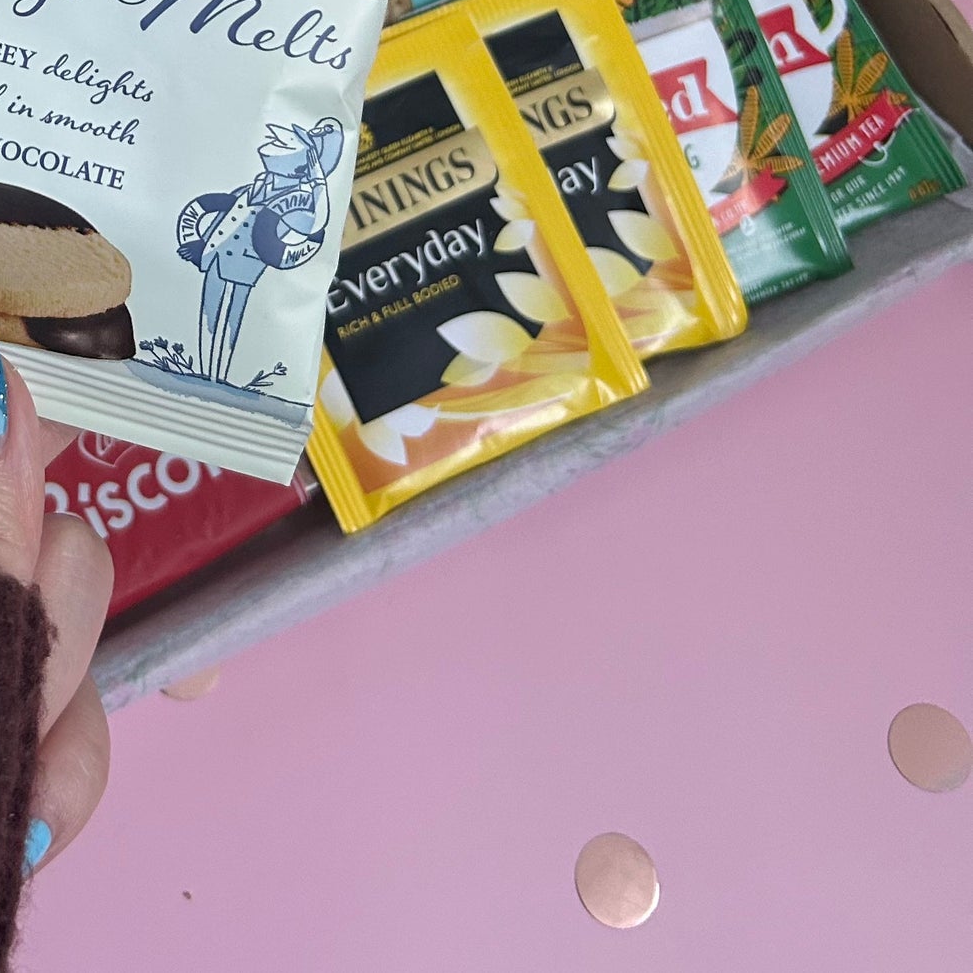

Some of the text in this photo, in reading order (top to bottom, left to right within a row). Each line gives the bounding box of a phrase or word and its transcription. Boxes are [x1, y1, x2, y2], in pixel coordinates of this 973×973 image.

[42, 54, 155, 105] delights
[7, 93, 35, 120] in
[38, 100, 138, 146] smooth
[816, 113, 886, 175] EMIUM TEA
[348, 146, 476, 231] ININGS
[830, 185, 847, 204] OR
[857, 182, 888, 210] SINCE
[181, 205, 200, 242] MULL
[284, 244, 316, 264] MULL
[326, 217, 489, 315] Everyday
[337, 273, 461, 340] RICH & FULL BODIED
